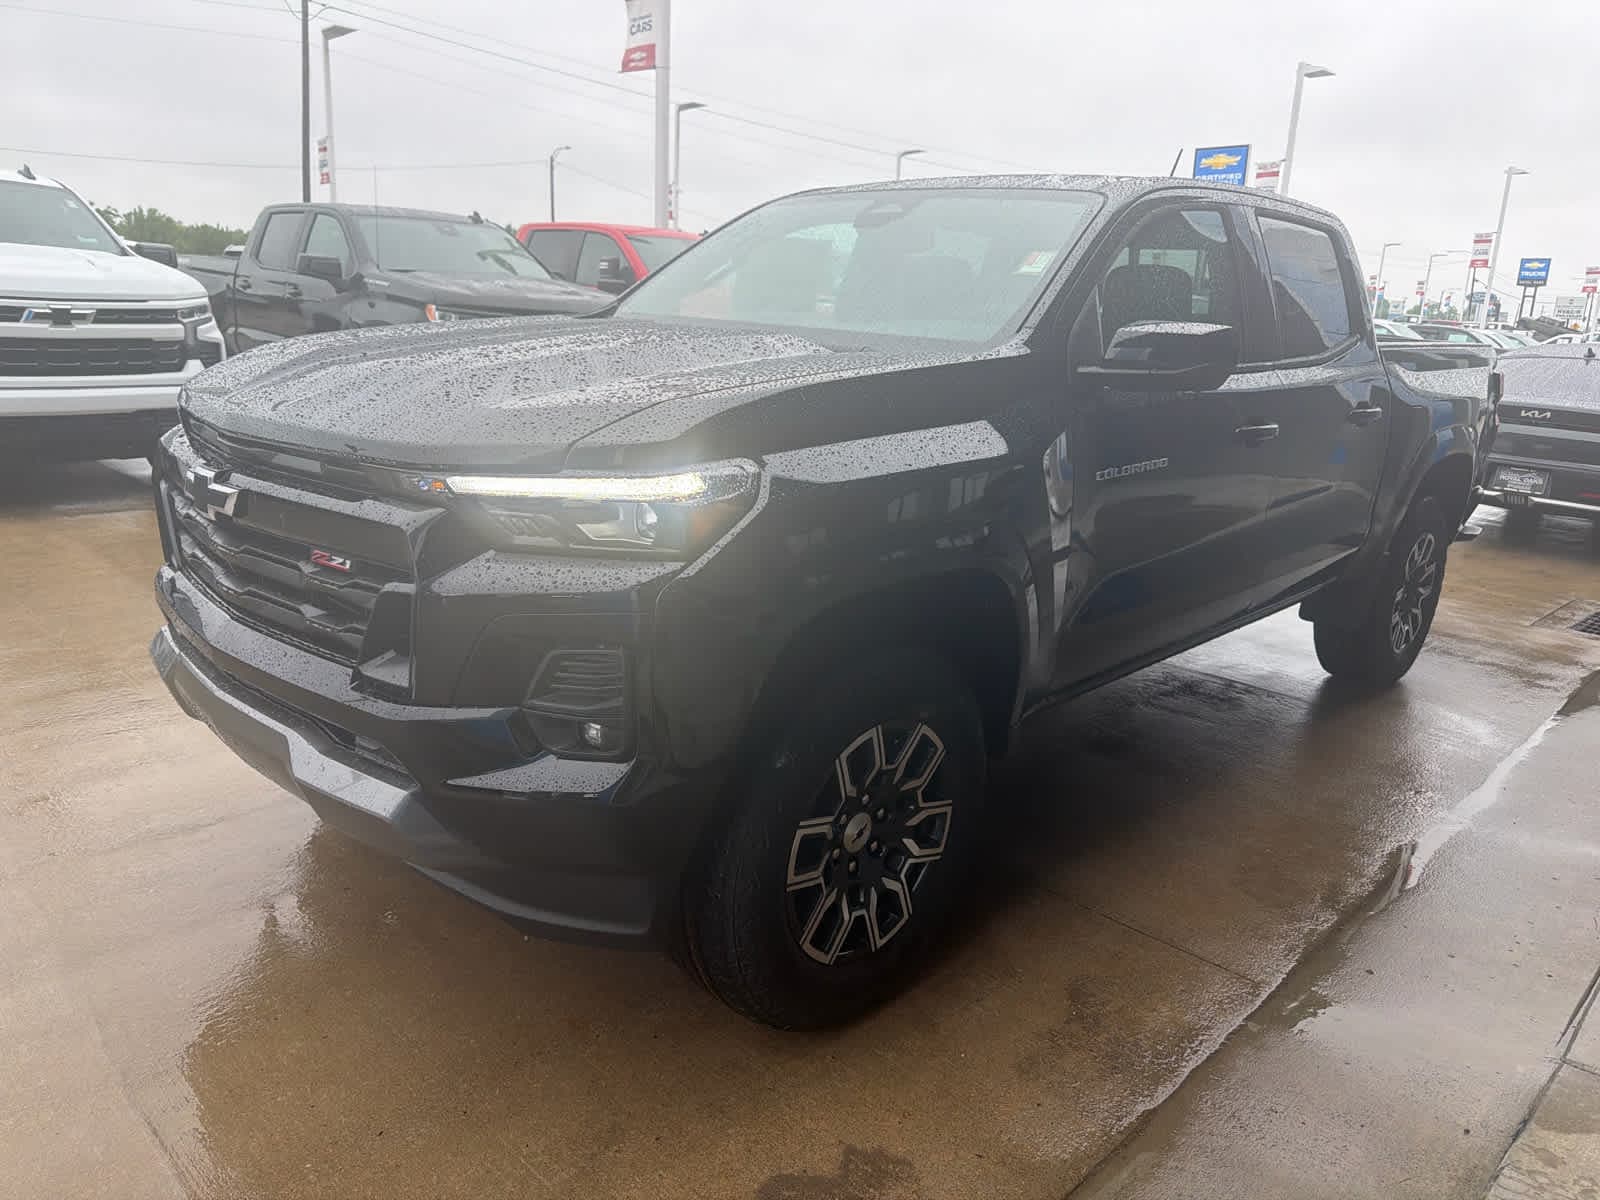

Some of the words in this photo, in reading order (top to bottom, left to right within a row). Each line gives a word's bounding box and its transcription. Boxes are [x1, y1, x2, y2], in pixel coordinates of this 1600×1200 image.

[630, 20, 653, 36] CARS
[1521, 409, 1552, 418] KIA
[1095, 457, 1169, 481] COLORADO
[312, 549, 351, 573] Z71
